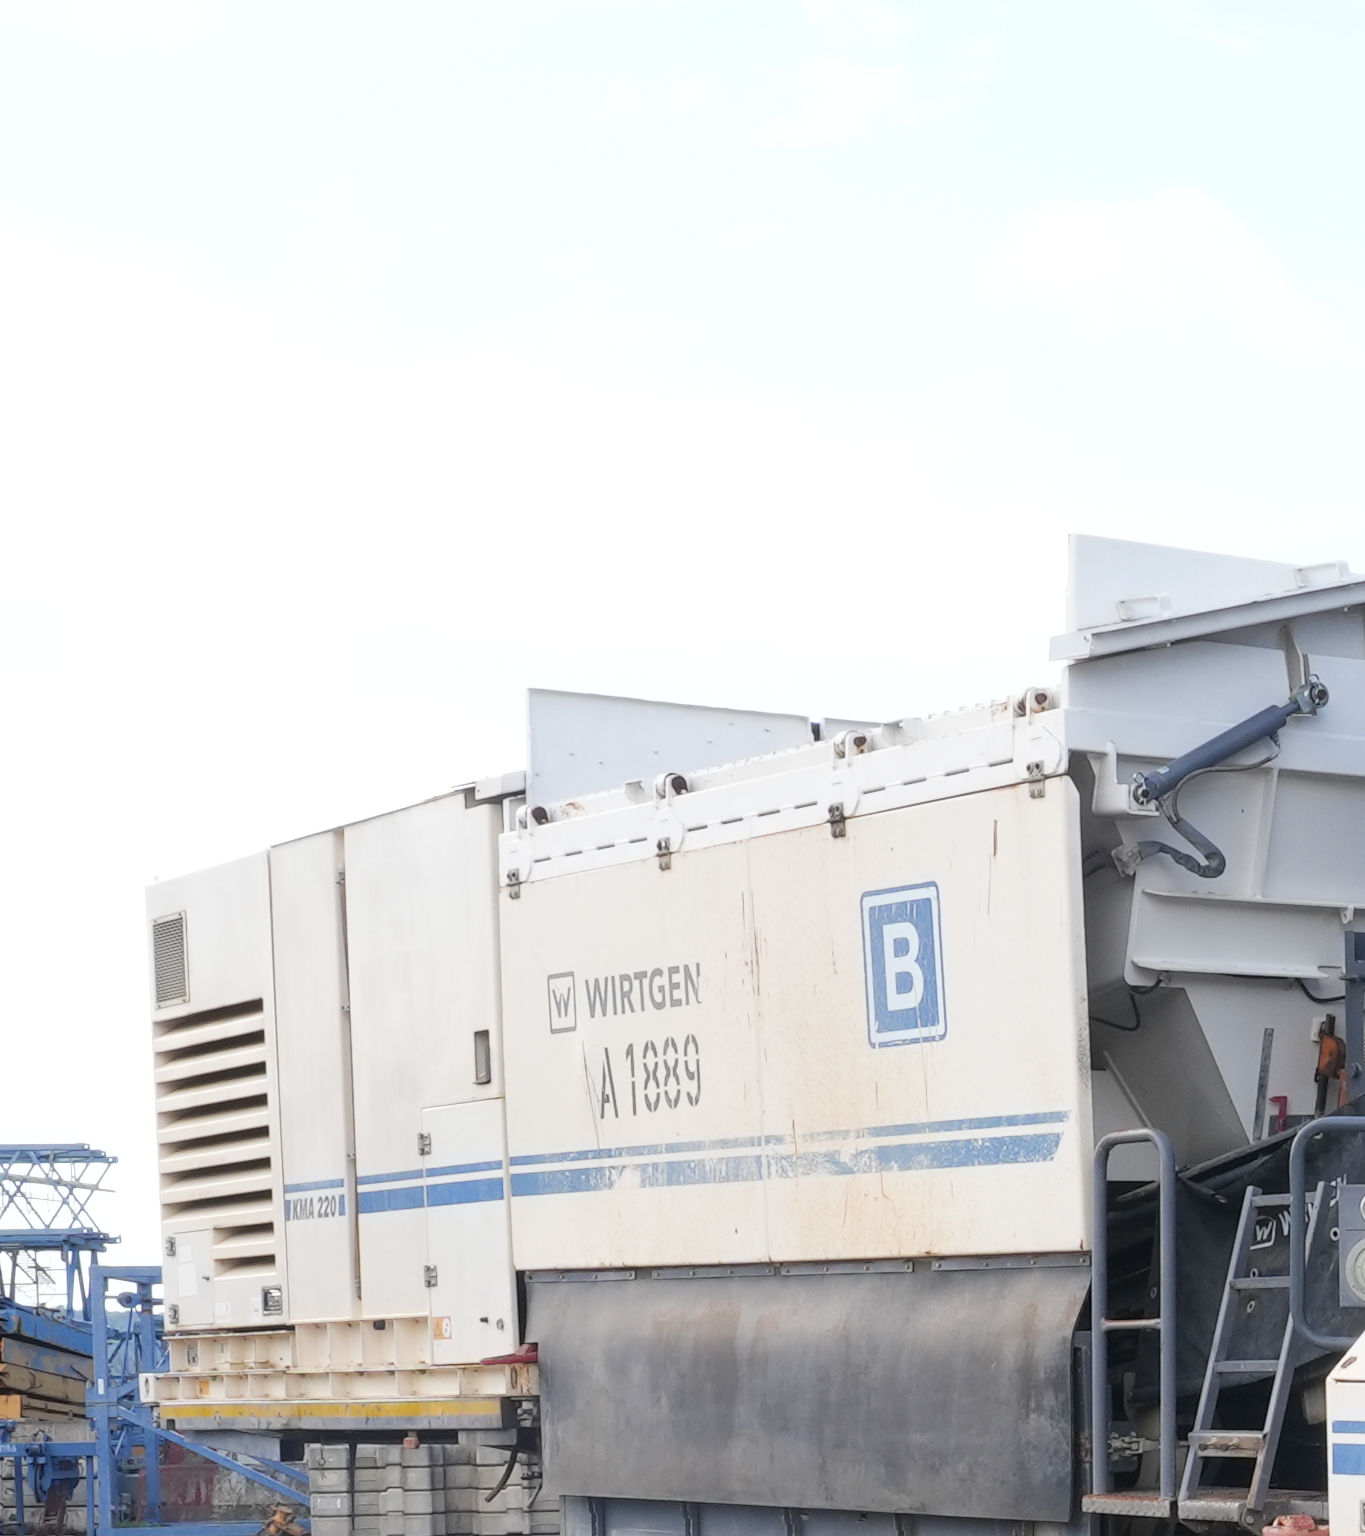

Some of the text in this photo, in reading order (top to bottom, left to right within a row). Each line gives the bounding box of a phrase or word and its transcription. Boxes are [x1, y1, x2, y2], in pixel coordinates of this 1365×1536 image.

[584, 962, 702, 1019] WIRTGEN
[882, 921, 925, 1012] B
[599, 1033, 701, 1119] A 1889
[292, 1194, 337, 1220] KMA 220
